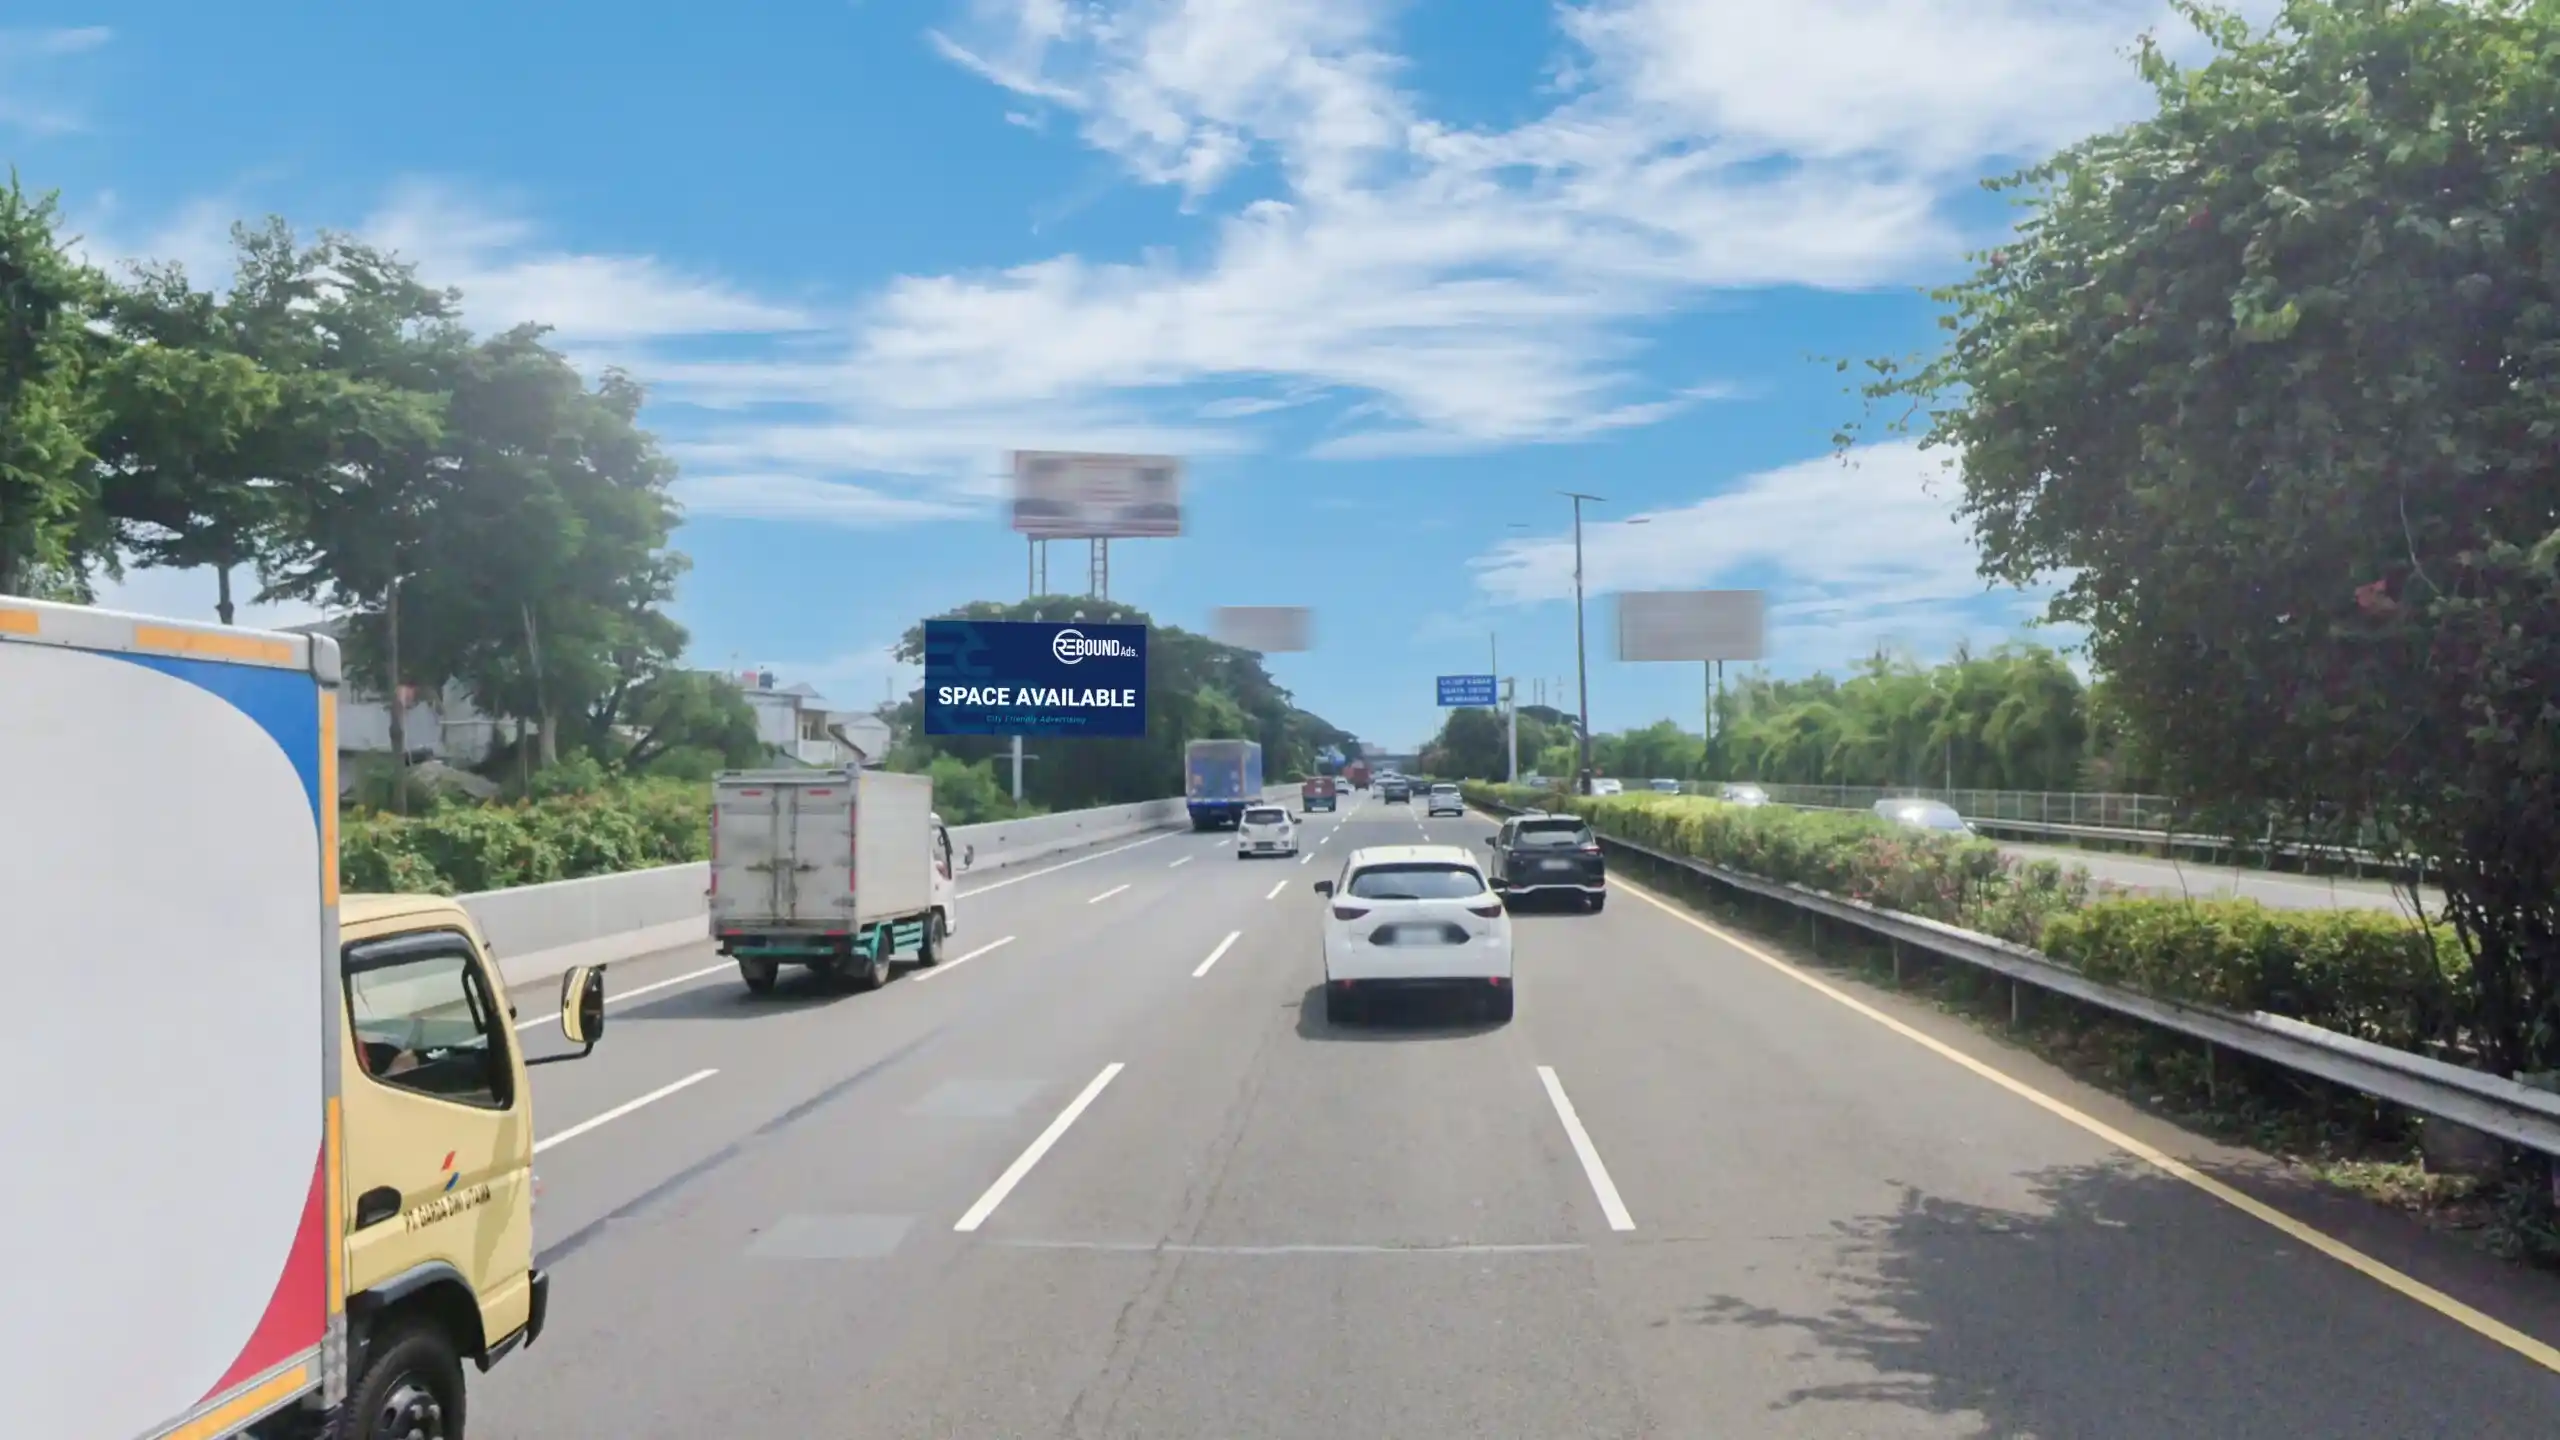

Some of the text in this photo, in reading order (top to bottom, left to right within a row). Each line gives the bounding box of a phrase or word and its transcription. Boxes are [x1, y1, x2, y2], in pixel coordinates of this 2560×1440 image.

[1053, 637, 1139, 657] REBOUND Ads.
[938, 686, 1136, 708] SPACE AVAILABLE
[986, 715, 1003, 724] City
[1005, 715, 1038, 724] Friendly
